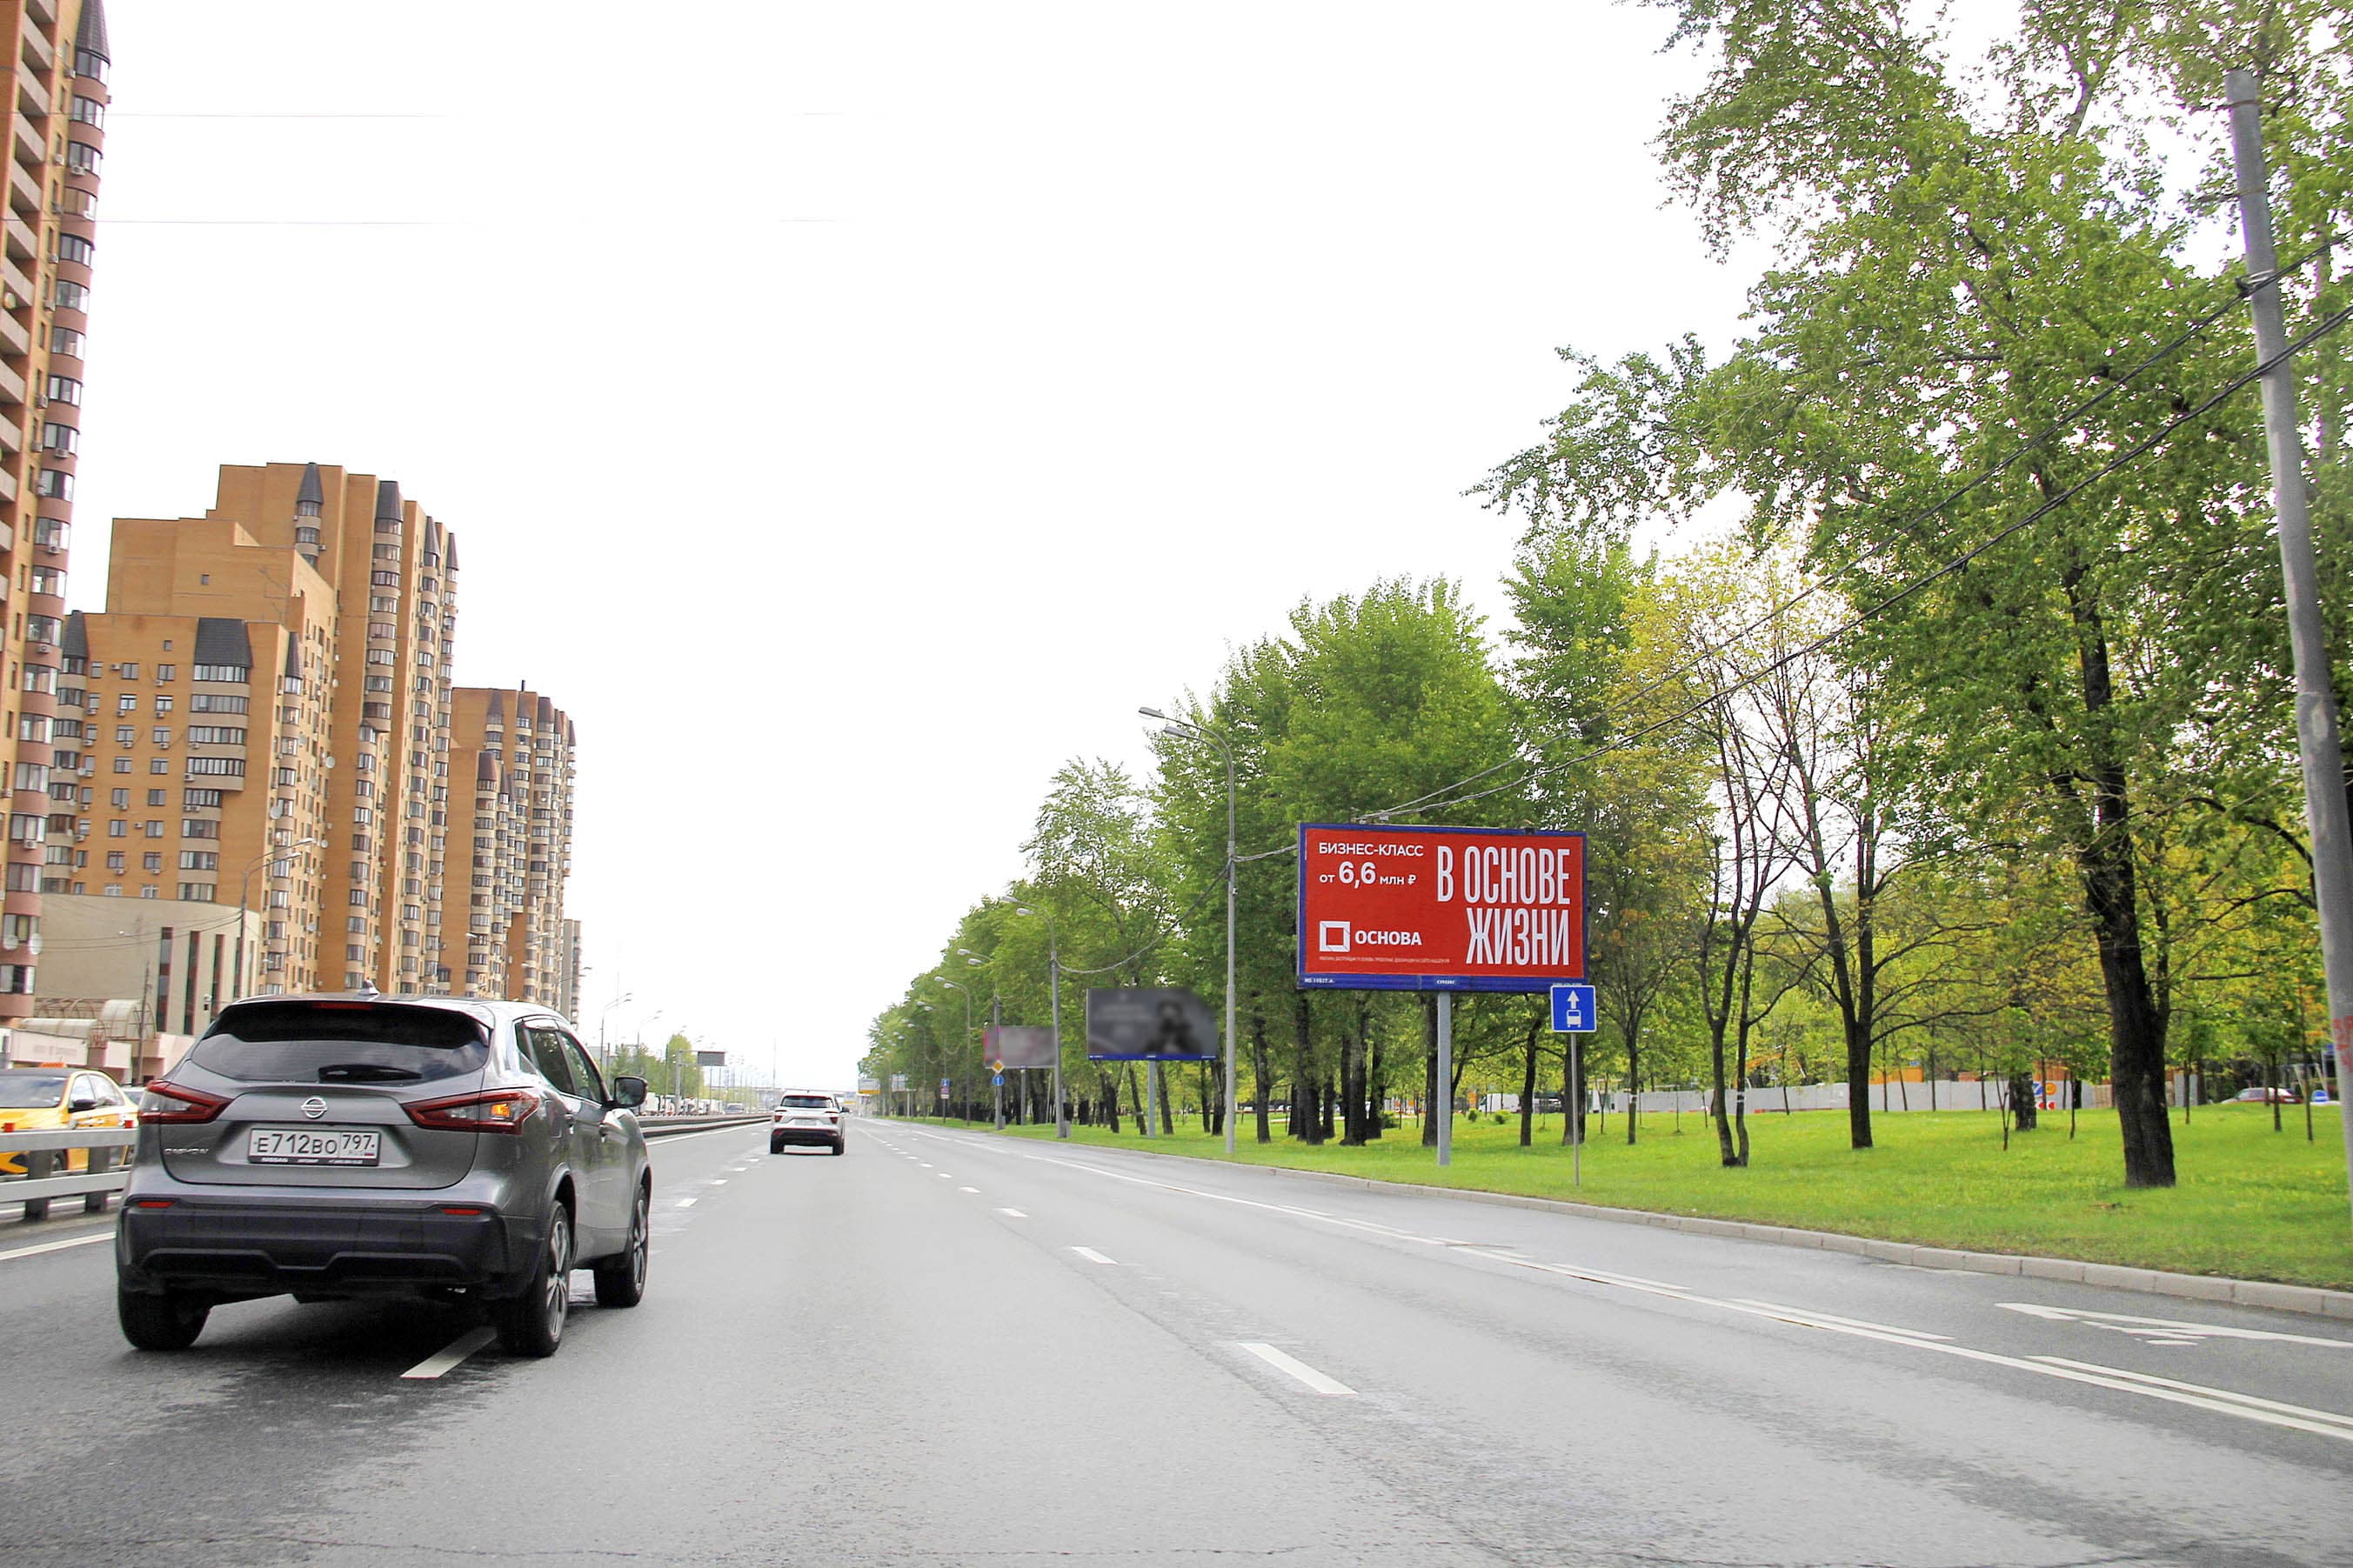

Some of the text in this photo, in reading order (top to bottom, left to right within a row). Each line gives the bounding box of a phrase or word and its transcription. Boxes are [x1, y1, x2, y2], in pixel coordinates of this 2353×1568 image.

[1319, 842, 1424, 857] БИЗНЕС-КЛАСС
[1339, 861, 1376, 889] 6,6
[1437, 845, 1571, 905] В ОСНОВЕ
[1354, 930, 1422, 946] ОСНОВА
[1465, 907, 1569, 966] ЖИЗНИ
[342, 1134, 372, 1150] 797
